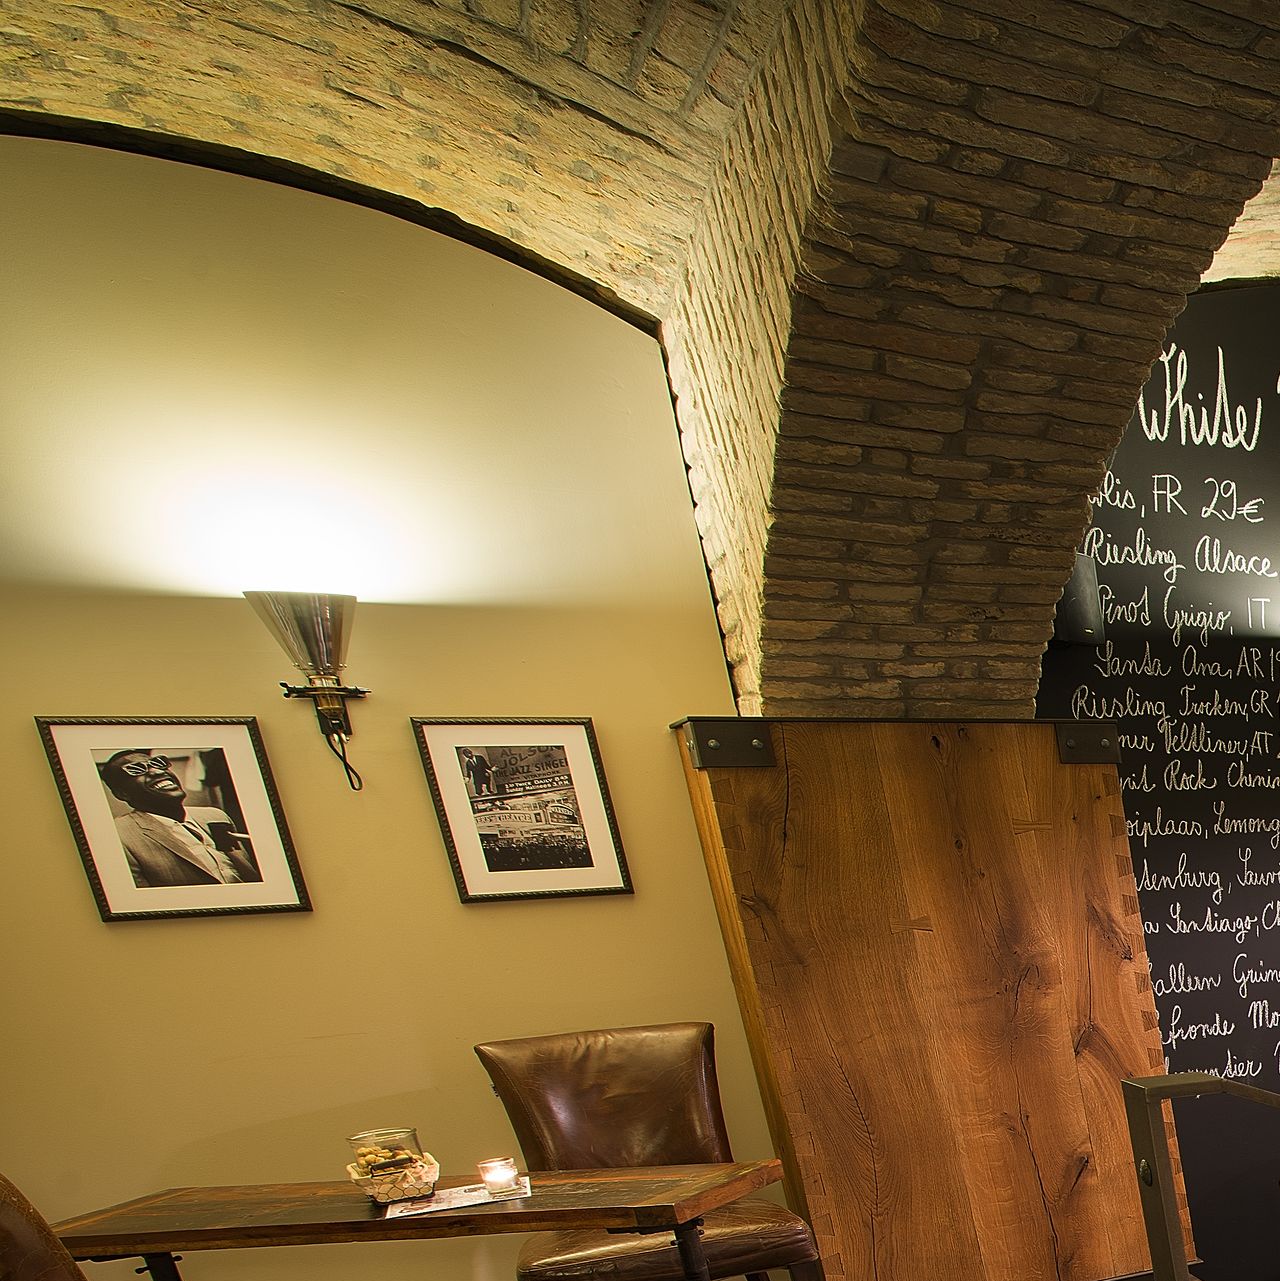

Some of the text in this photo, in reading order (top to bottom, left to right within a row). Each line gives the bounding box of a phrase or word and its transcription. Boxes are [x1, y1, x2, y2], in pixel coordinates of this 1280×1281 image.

[1138, 343, 1263, 452] White
[1152, 474, 1188, 516] FR
[1083, 526, 1187, 584] Riesling
[1247, 597, 1271, 630] IT
[1236, 646, 1265, 682] AR
